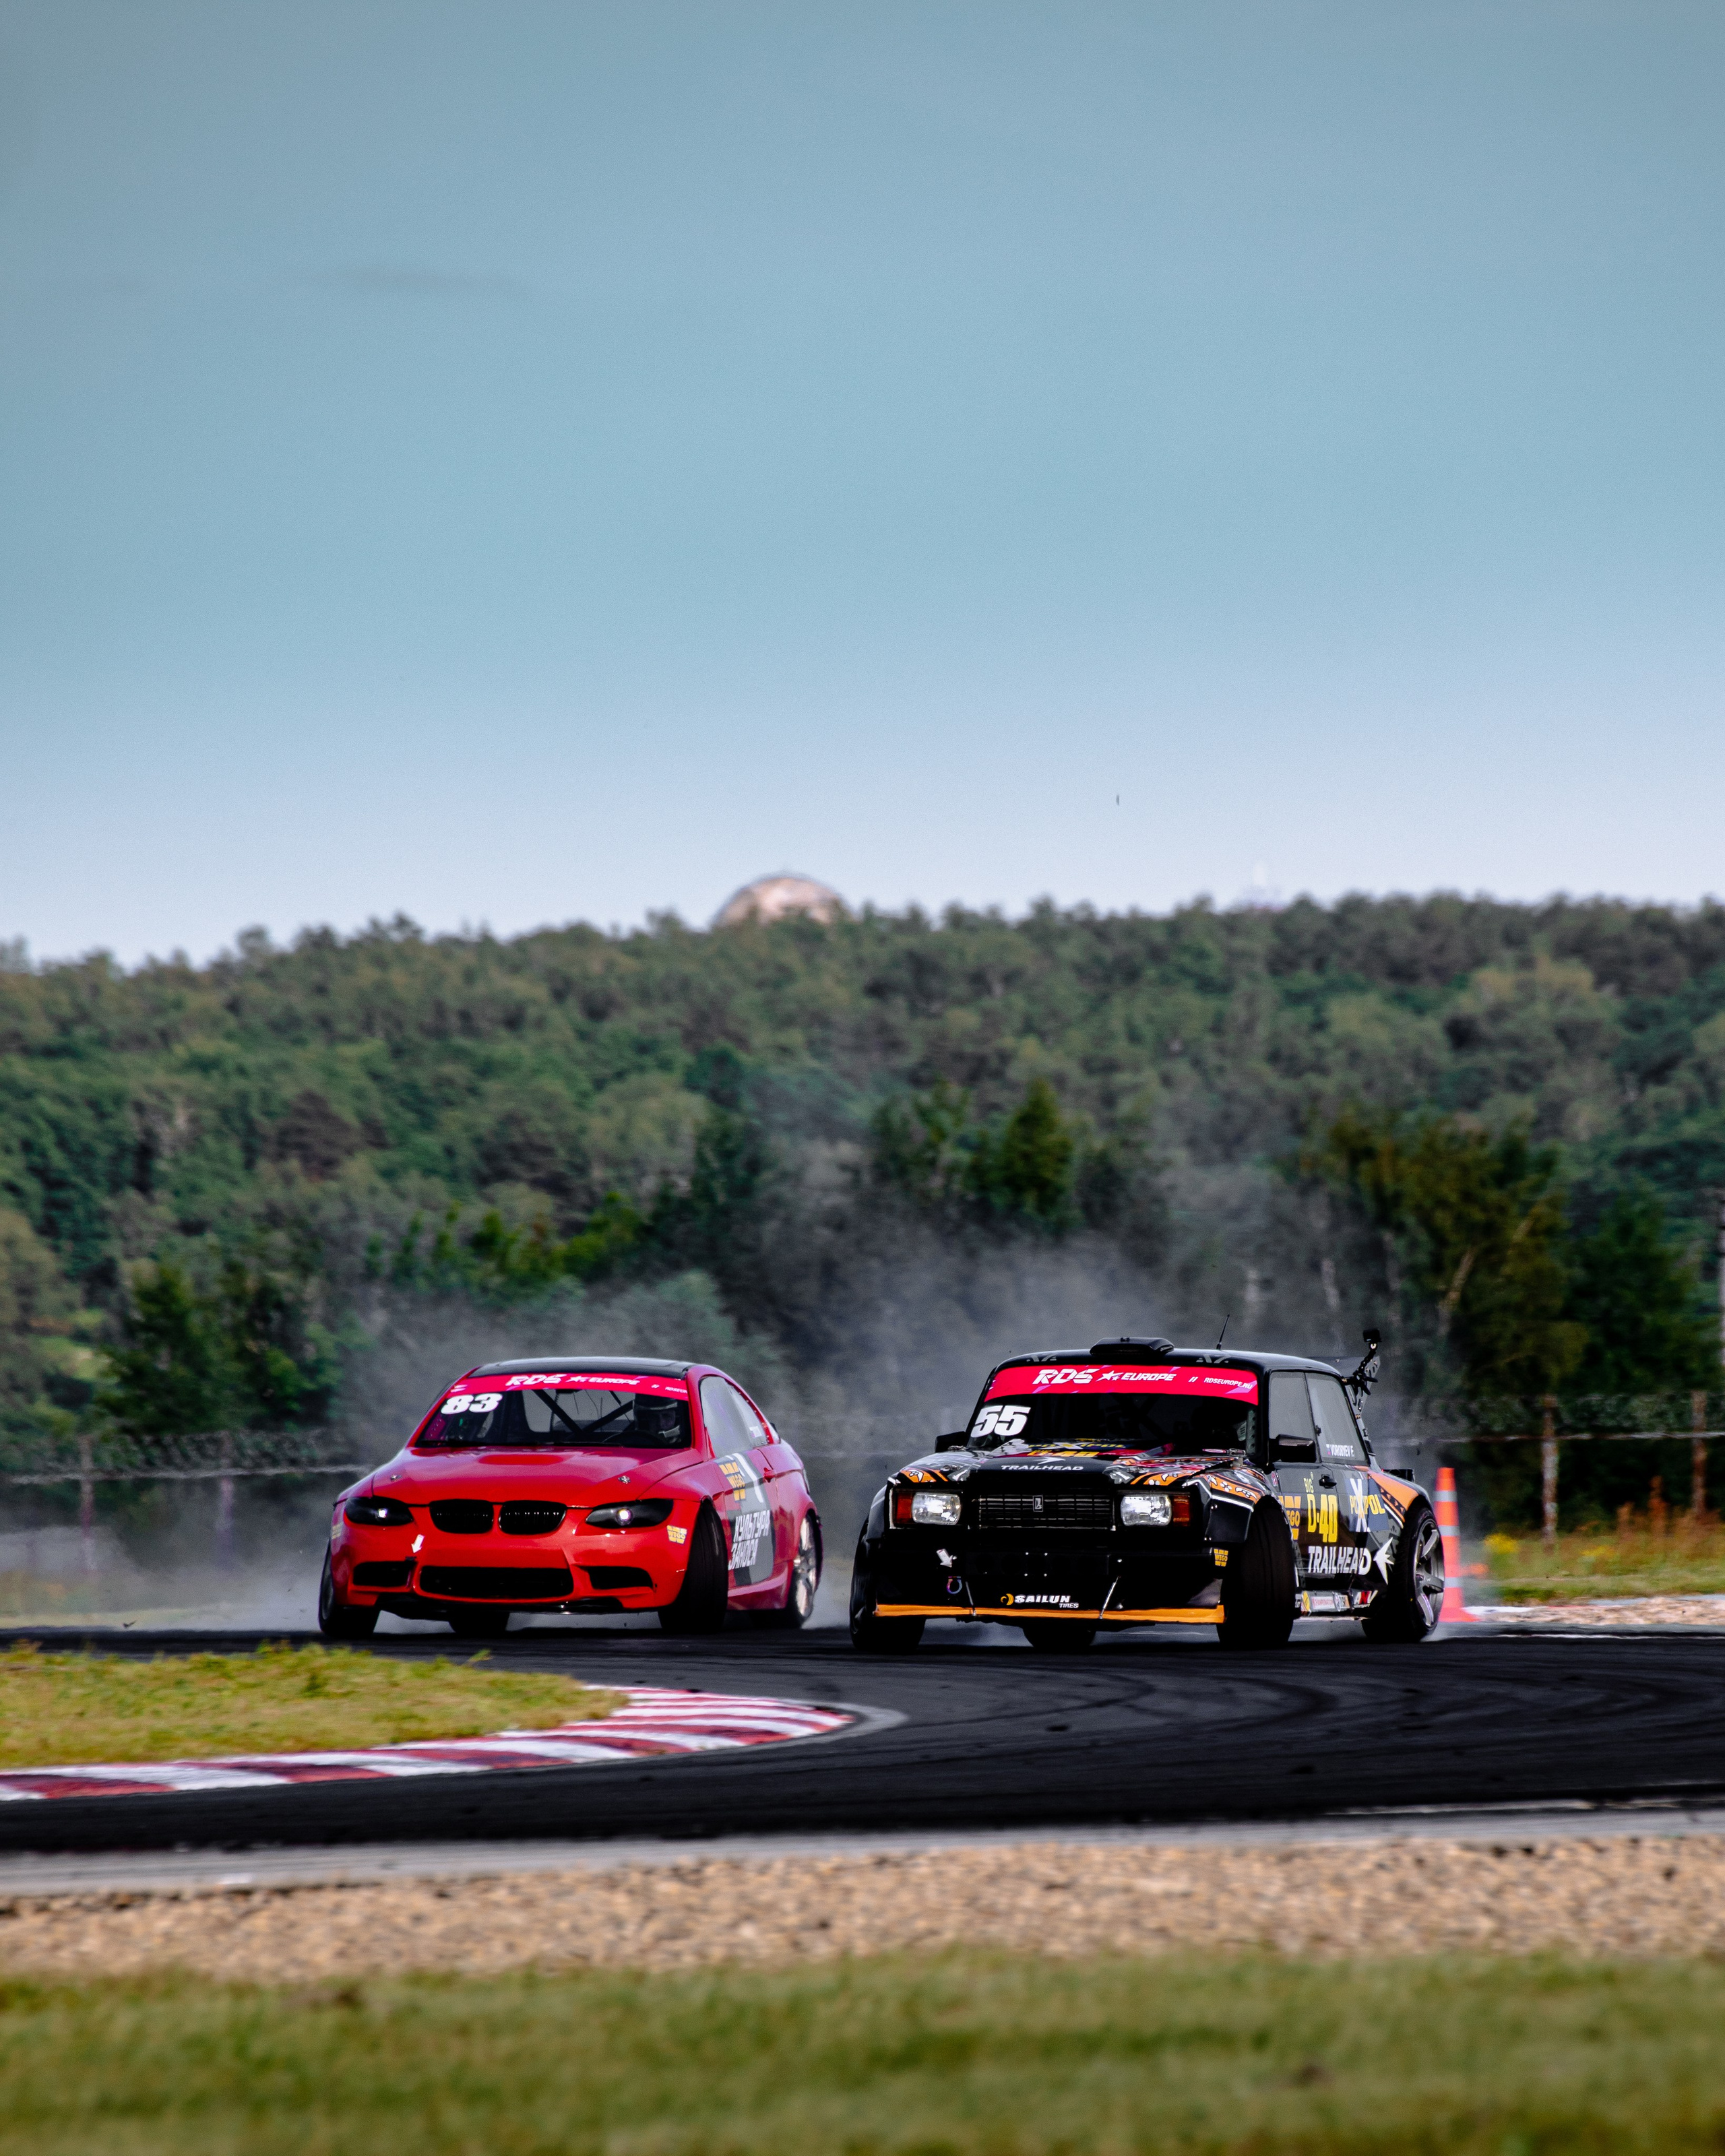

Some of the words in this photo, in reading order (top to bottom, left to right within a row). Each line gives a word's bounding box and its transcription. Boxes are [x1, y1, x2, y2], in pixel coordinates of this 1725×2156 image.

[505, 1374, 568, 1386] RDS
[588, 1377, 640, 1385] EUROPE
[1032, 1368, 1100, 1385] RDS
[1121, 1372, 1177, 1381] EUROPE
[1203, 1377, 1253, 1389] RDSEUROPE.RU
[441, 1393, 503, 1414] 83
[970, 1405, 1031, 1438] 55
[1303, 1478, 1314, 1494] BIG
[733, 1510, 770, 1543] КУЛЬТУРА
[1286, 1510, 1300, 1527] EGO
[728, 1538, 759, 1571] ЗАНОСА
[1308, 1546, 1372, 1575] TRAILHEAD
[1014, 1594, 1071, 1604] SAILUN
